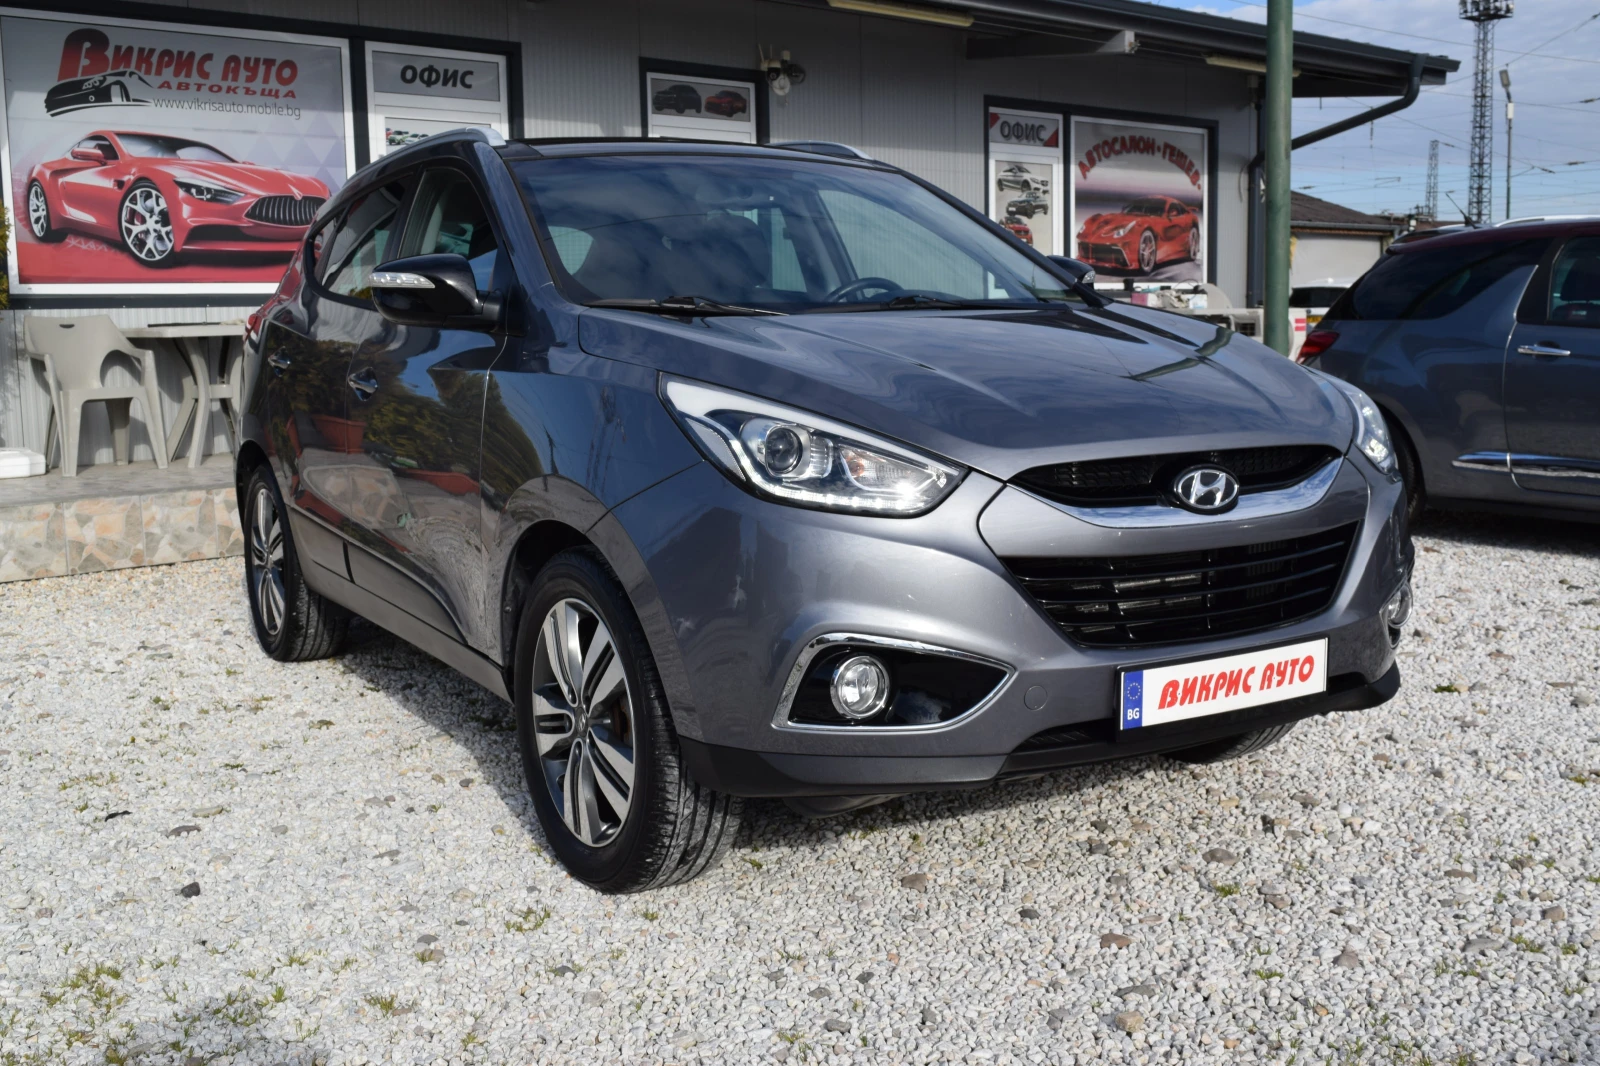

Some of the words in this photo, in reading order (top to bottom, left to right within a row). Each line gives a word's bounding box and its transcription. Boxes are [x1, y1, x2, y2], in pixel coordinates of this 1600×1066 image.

[221, 54, 298, 86] АУТО
[400, 64, 474, 89] ОФИС
[157, 80, 297, 99] АВТОКЪЩА
[153, 97, 301, 120] www.vikrisauto.mobile.bg
[1000, 120, 1046, 142] ОФИС
[1078, 135, 1156, 180] АВТОСАЛОН
[1158, 666, 1256, 710] ВИКРИС
[1259, 655, 1315, 691] АУТО
[1127, 708, 1140, 720] BG
